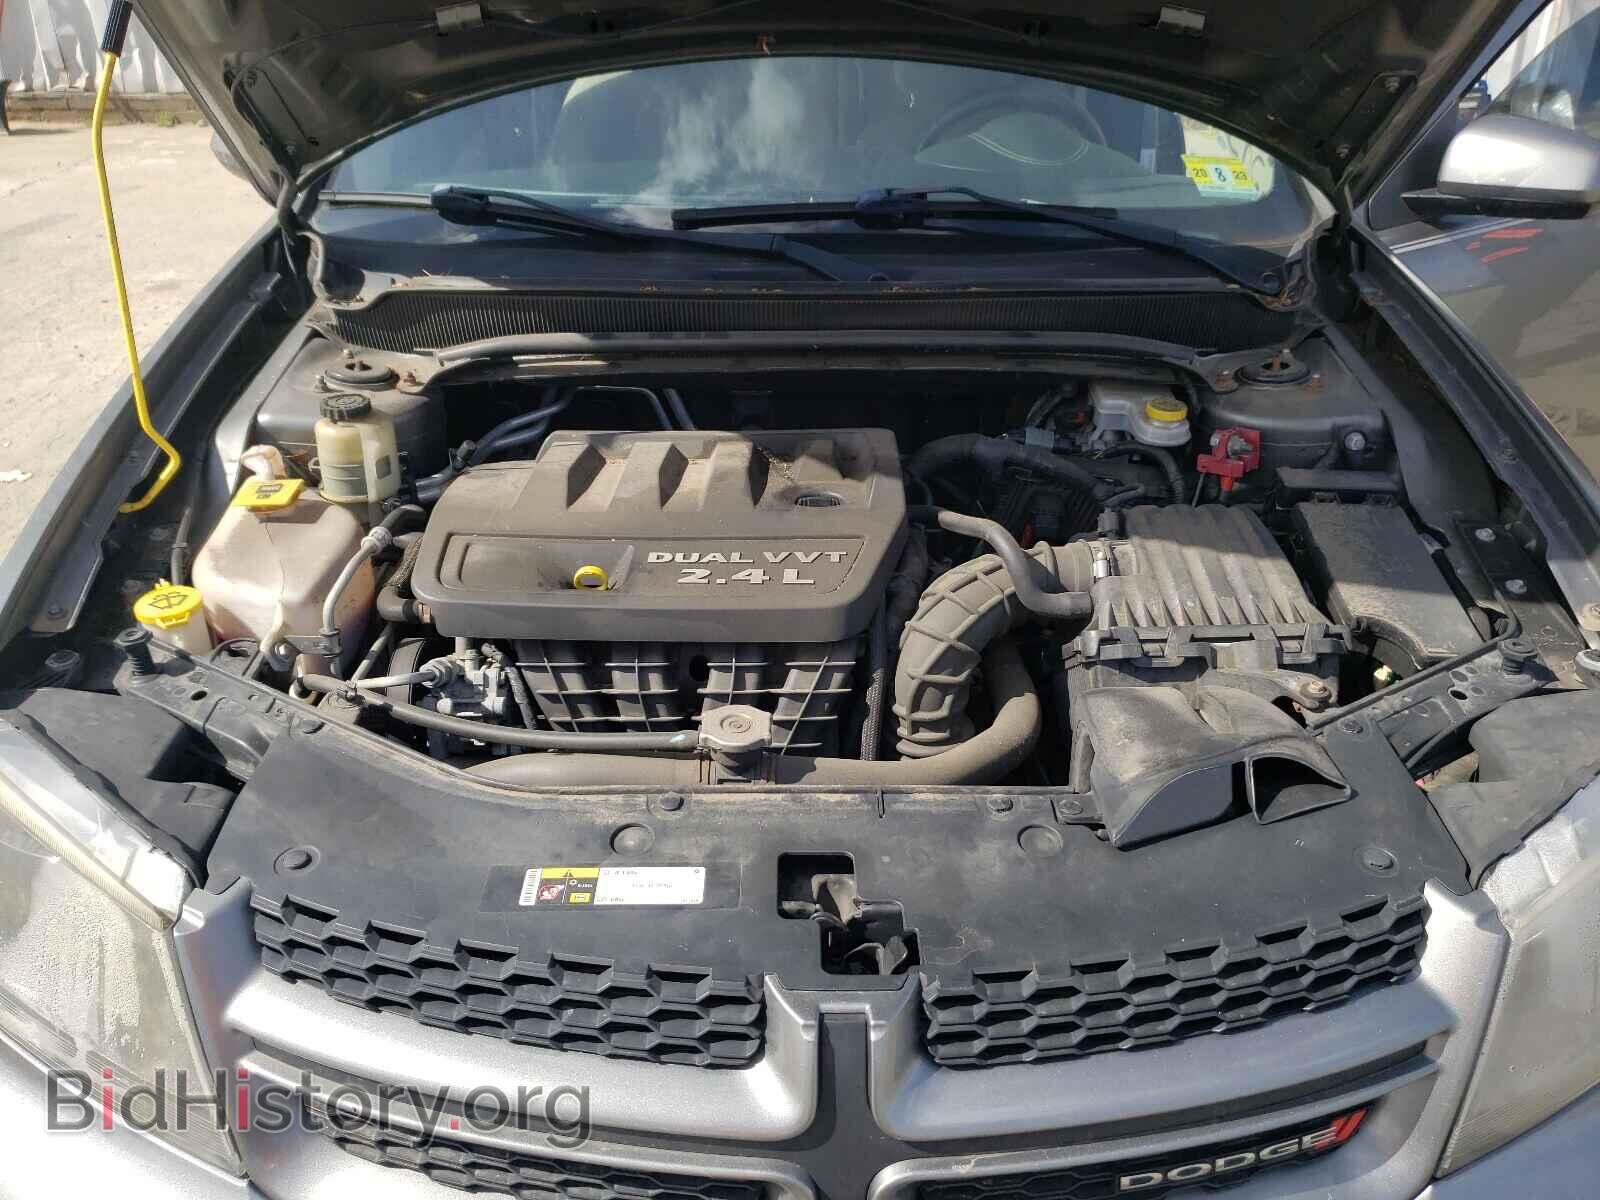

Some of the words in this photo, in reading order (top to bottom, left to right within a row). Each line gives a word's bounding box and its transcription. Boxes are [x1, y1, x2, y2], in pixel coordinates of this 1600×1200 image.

[1192, 168, 1208, 178] 20
[1215, 167, 1226, 182] 8
[647, 551, 754, 564] DUAL
[763, 551, 849, 564] VVT
[1119, 1126, 1337, 1191] DODGE
